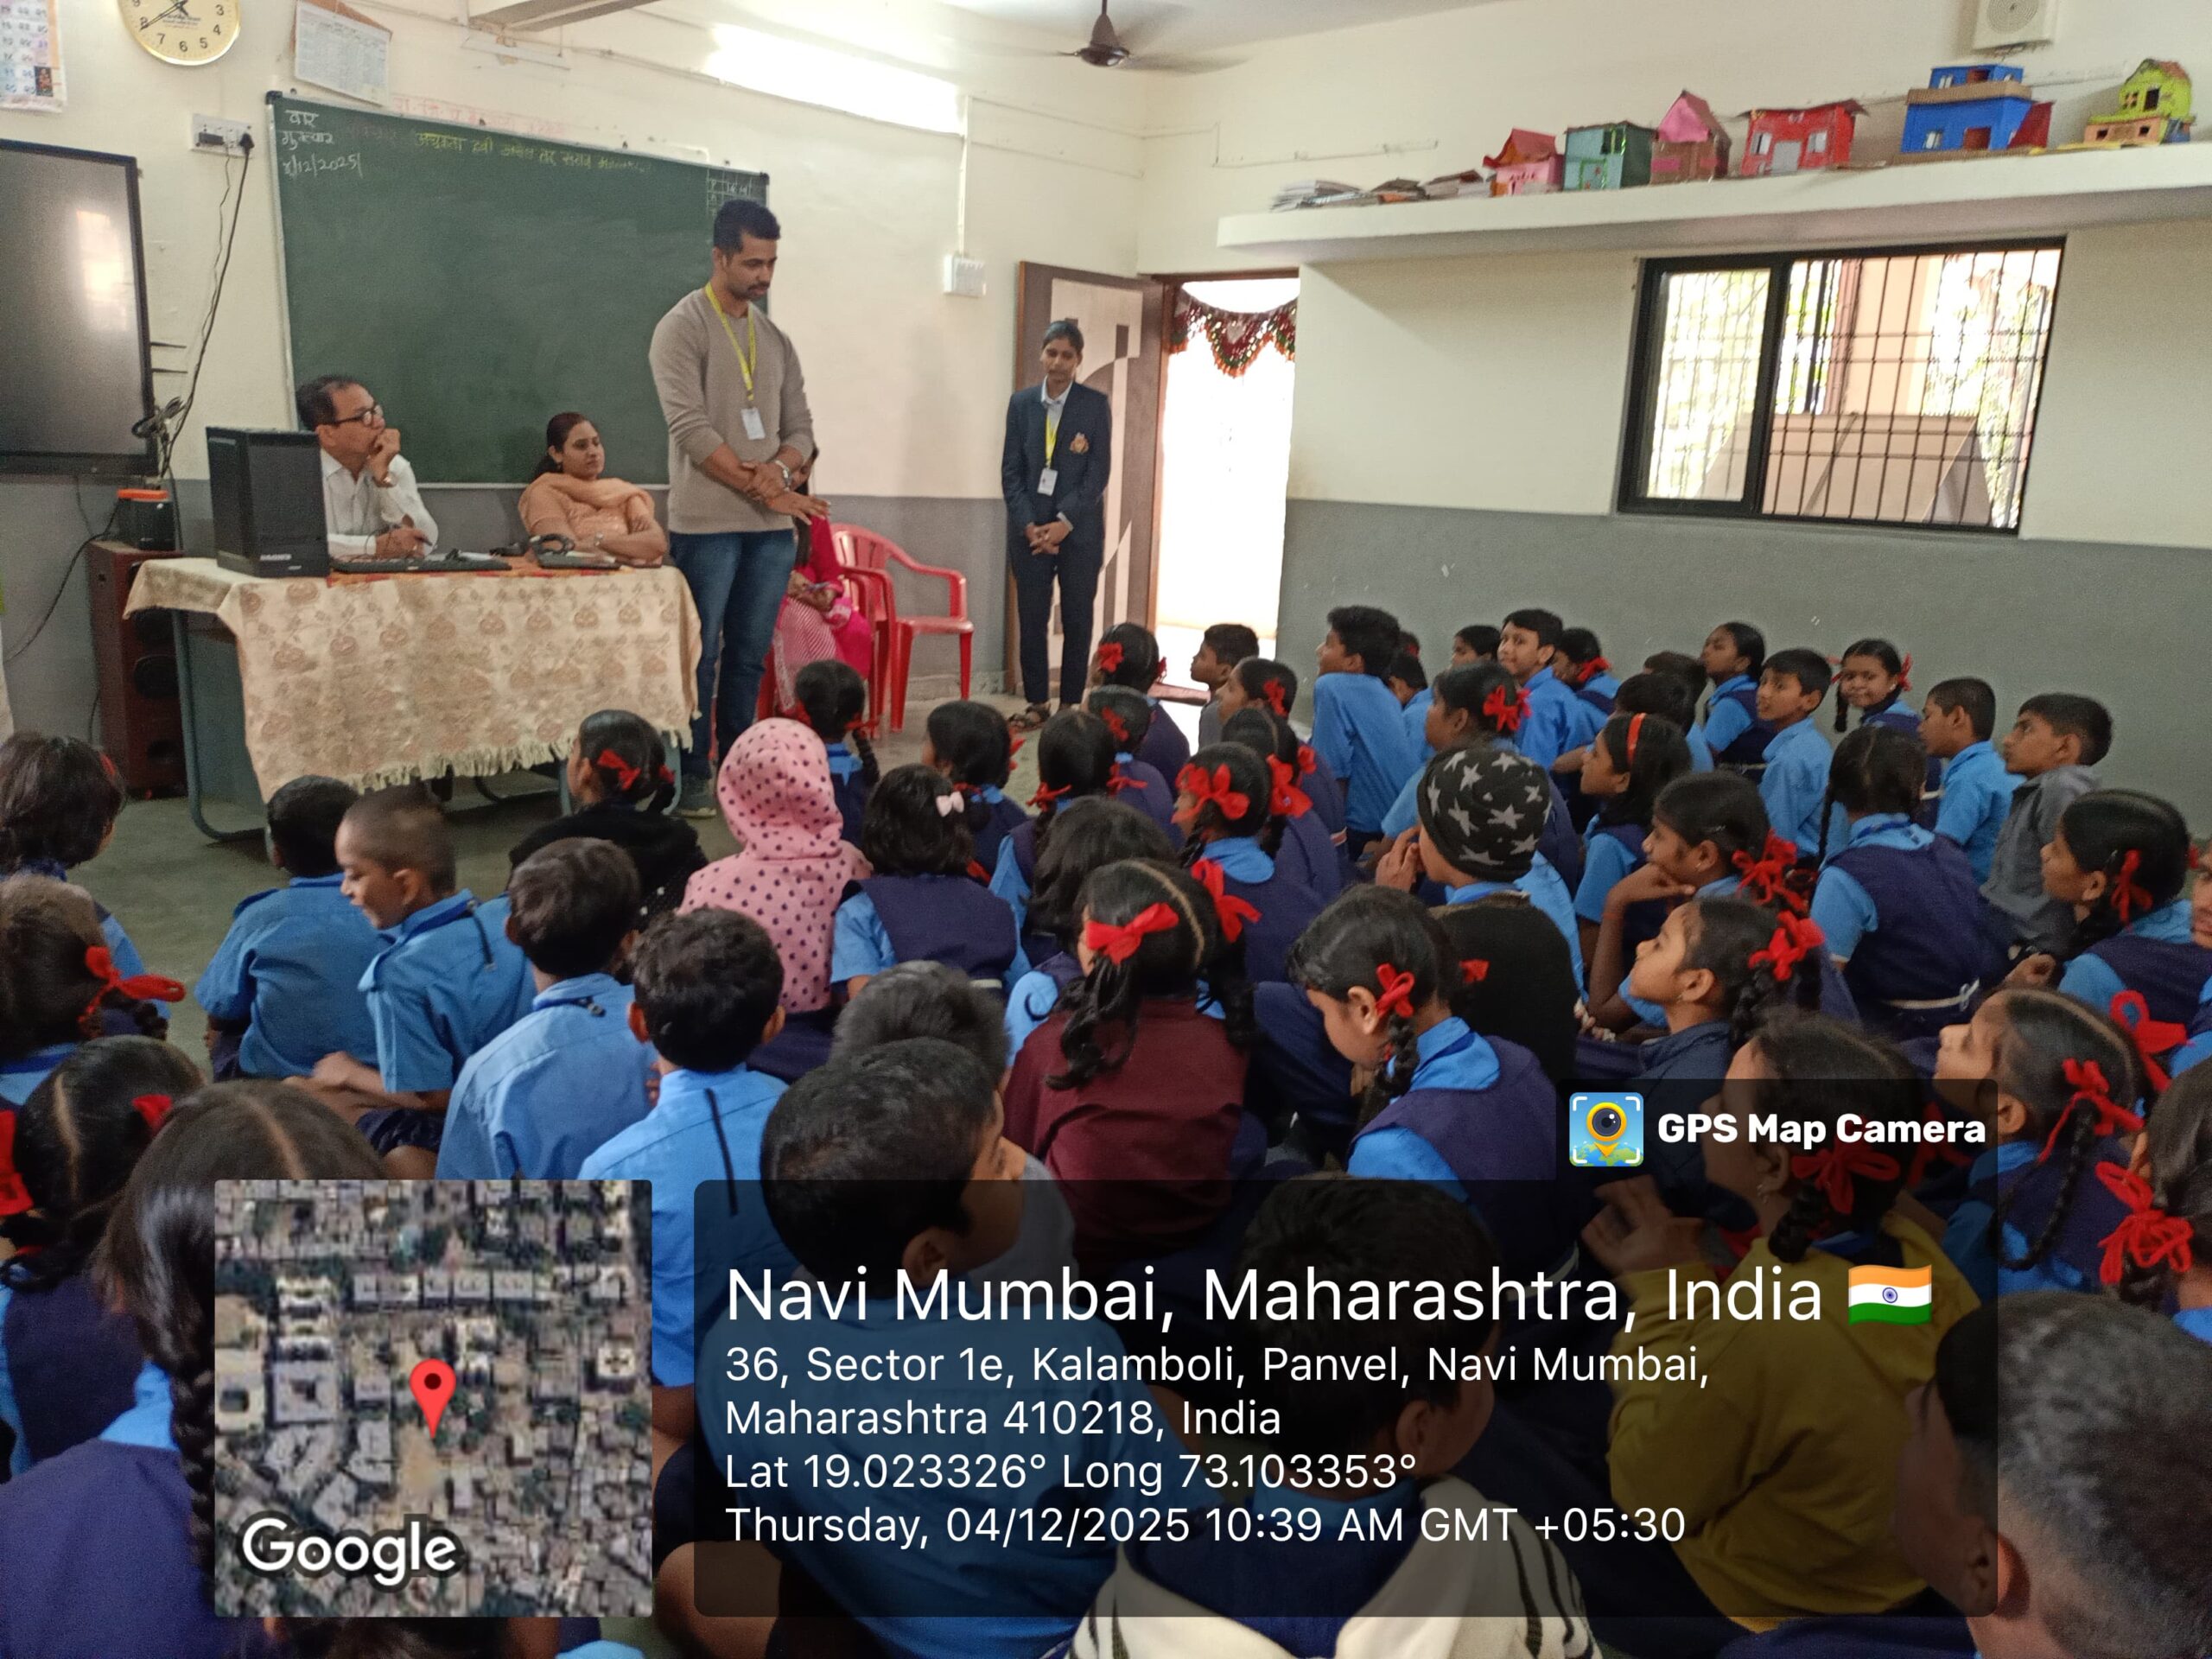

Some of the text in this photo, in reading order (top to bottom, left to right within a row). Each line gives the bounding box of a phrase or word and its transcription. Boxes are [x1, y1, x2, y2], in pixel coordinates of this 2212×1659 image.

[215, 4, 225, 16] 3
[213, 24, 222, 35] 4
[156, 33, 166, 45] 7
[199, 37, 208, 48] 5
[179, 41, 188, 53] 6
